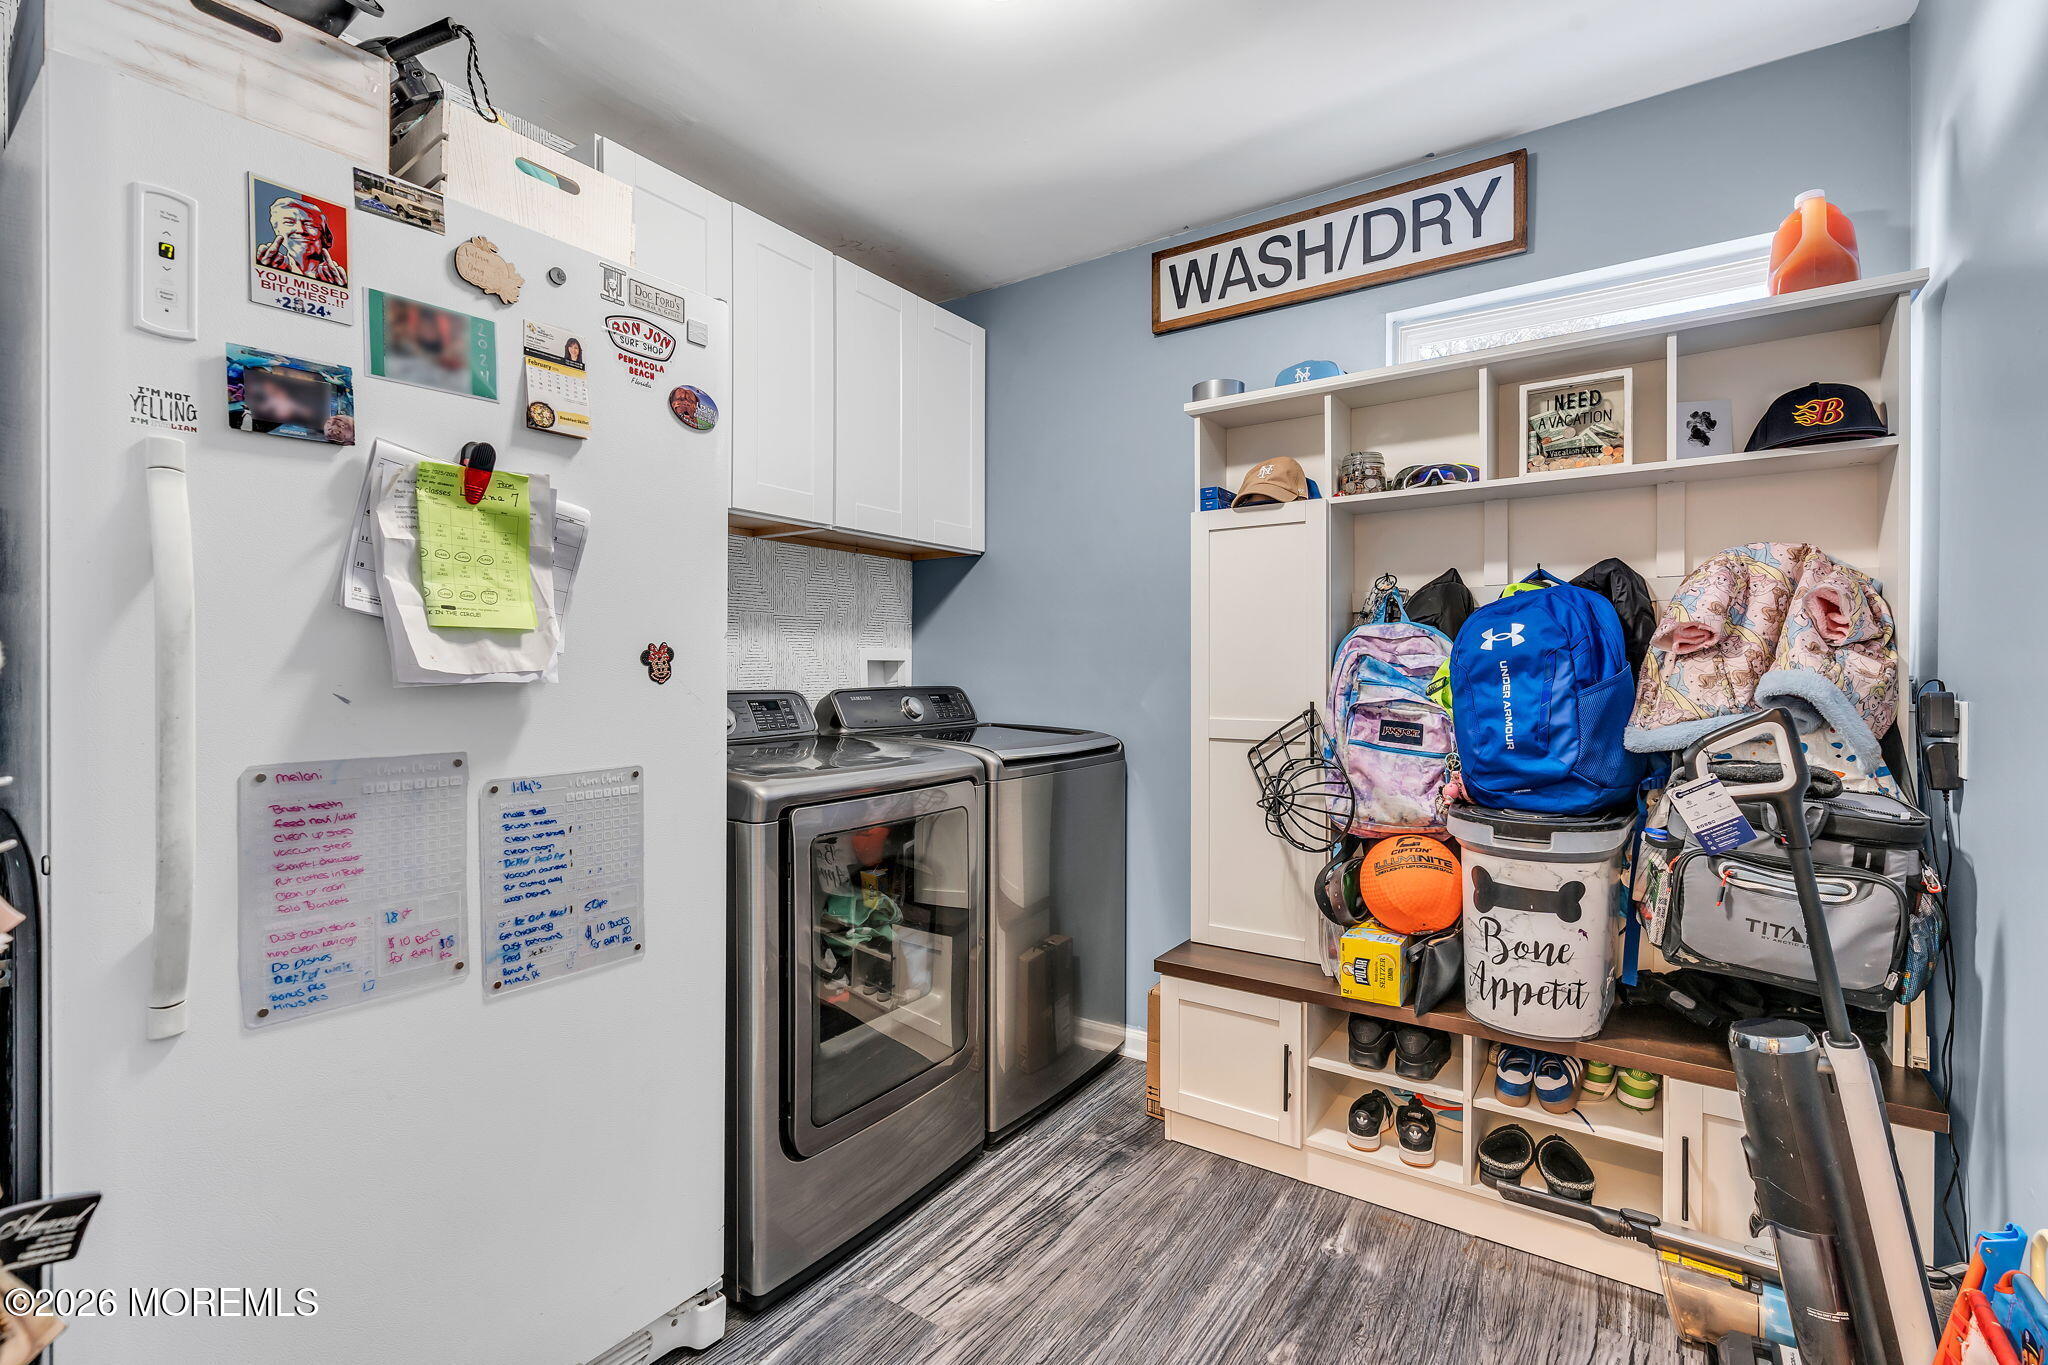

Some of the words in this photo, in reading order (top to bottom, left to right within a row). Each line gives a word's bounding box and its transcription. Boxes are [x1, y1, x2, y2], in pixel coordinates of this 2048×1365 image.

[1168, 176, 1502, 309] WASH/DRY
[255, 268, 288, 284] YOU
[294, 278, 349, 300] MISSED
[282, 297, 326, 317] 224
[612, 321, 640, 336] RON
[643, 326, 671, 349] JON
[620, 335, 639, 349] SURF
[643, 341, 664, 355] SHOP
[528, 358, 552, 371] February
[618, 353, 665, 373] PENSACOLA
[629, 367, 655, 380] BEACH
[631, 377, 652, 388] Florida
[137, 386, 161, 397] I'M
[165, 391, 191, 402] NOT
[1554, 390, 1602, 410] NEED
[130, 394, 198, 422] YELLING
[130, 417, 149, 425] I'M
[1538, 418, 1547, 430] A
[1549, 409, 1612, 428] VACATION
[1549, 447, 1580, 458] Vacation
[1581, 446, 1599, 454] Fund
[424, 487, 451, 497] classes
[1499, 660, 1512, 698] UNDER
[1381, 725, 1421, 738] JANSPORT
[1502, 700, 1515, 750] ARMOUR
[596, 922, 605, 933] 10
[1745, 917, 1805, 943] TITA
[1479, 916, 1575, 966] Bone
[271, 962, 289, 973] Do
[1355, 959, 1368, 984] POLAR
[1469, 960, 1590, 1016] Appetit
[1630, 1070, 1647, 1079] NIKE
